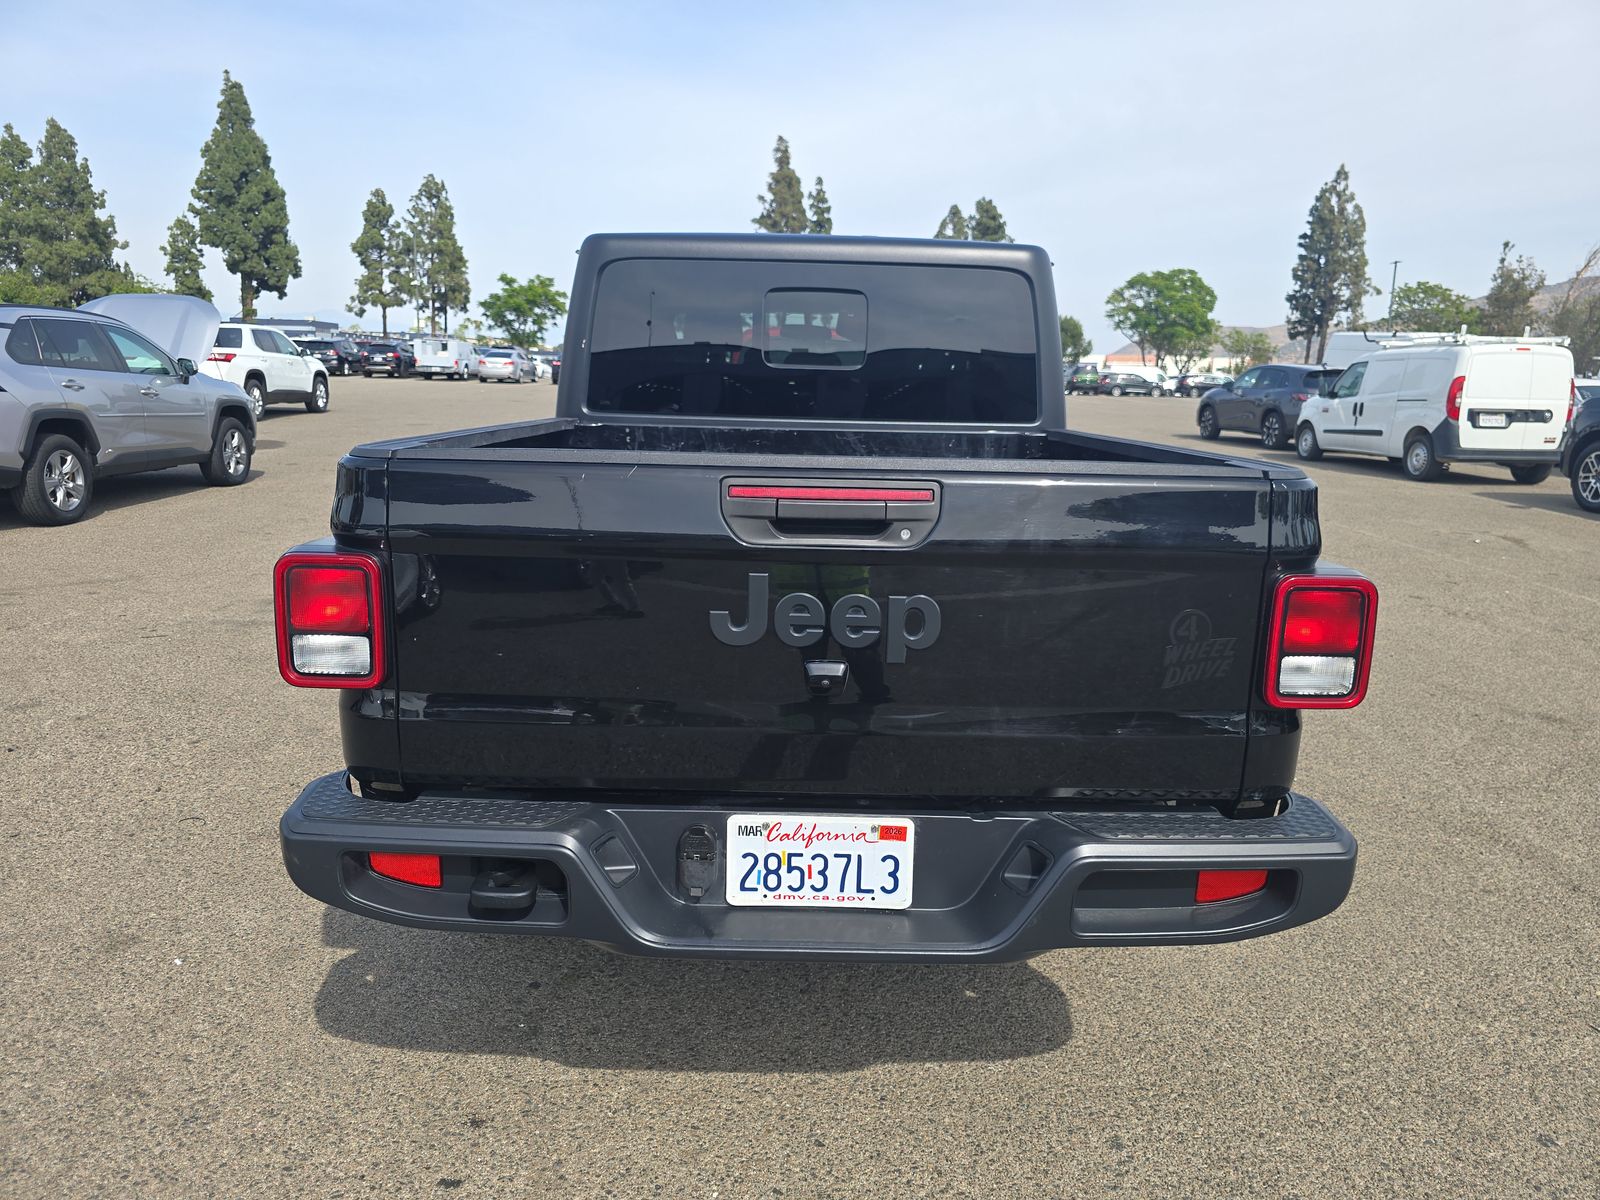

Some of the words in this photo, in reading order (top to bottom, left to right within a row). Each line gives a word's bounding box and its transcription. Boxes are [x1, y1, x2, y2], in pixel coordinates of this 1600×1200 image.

[710, 572, 942, 664] Jeep
[1177, 615, 1198, 640] 4
[1163, 638, 1237, 666] WHEEL
[1161, 657, 1233, 687] DRIVE
[738, 825, 763, 837] MAR
[766, 822, 879, 848] California
[885, 827, 902, 836] 2026
[740, 852, 900, 895] 28537L3
[773, 893, 866, 902] dmv.ca.gov
